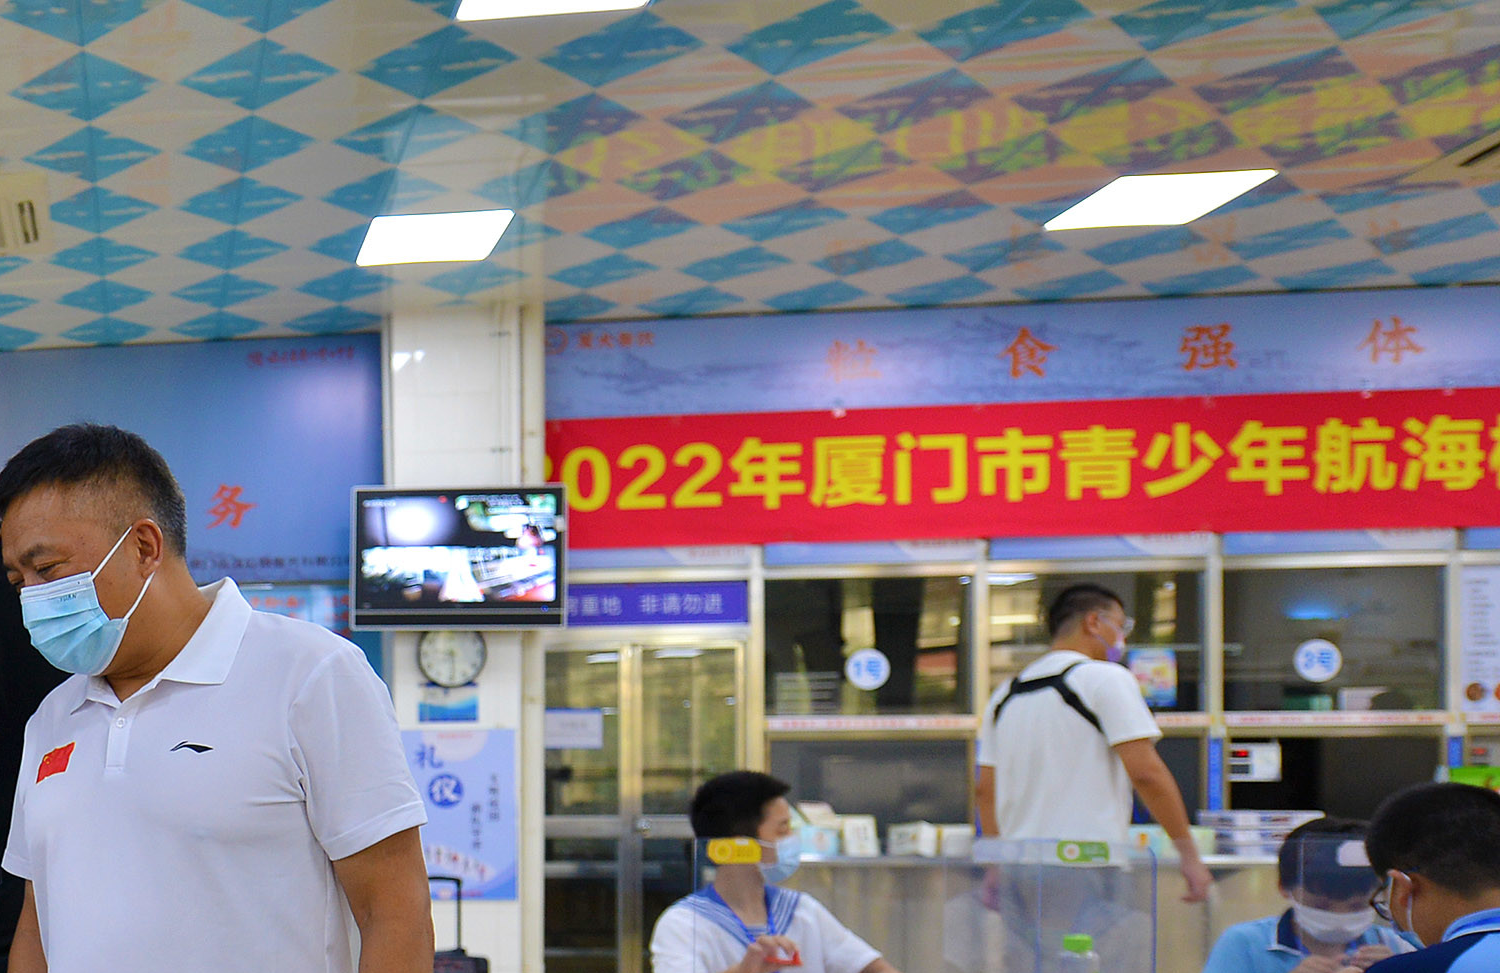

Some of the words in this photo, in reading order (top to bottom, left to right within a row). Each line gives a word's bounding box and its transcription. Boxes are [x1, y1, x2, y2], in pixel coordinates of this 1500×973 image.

[544, 413, 1500, 513] 022年厦门市青少年航海
